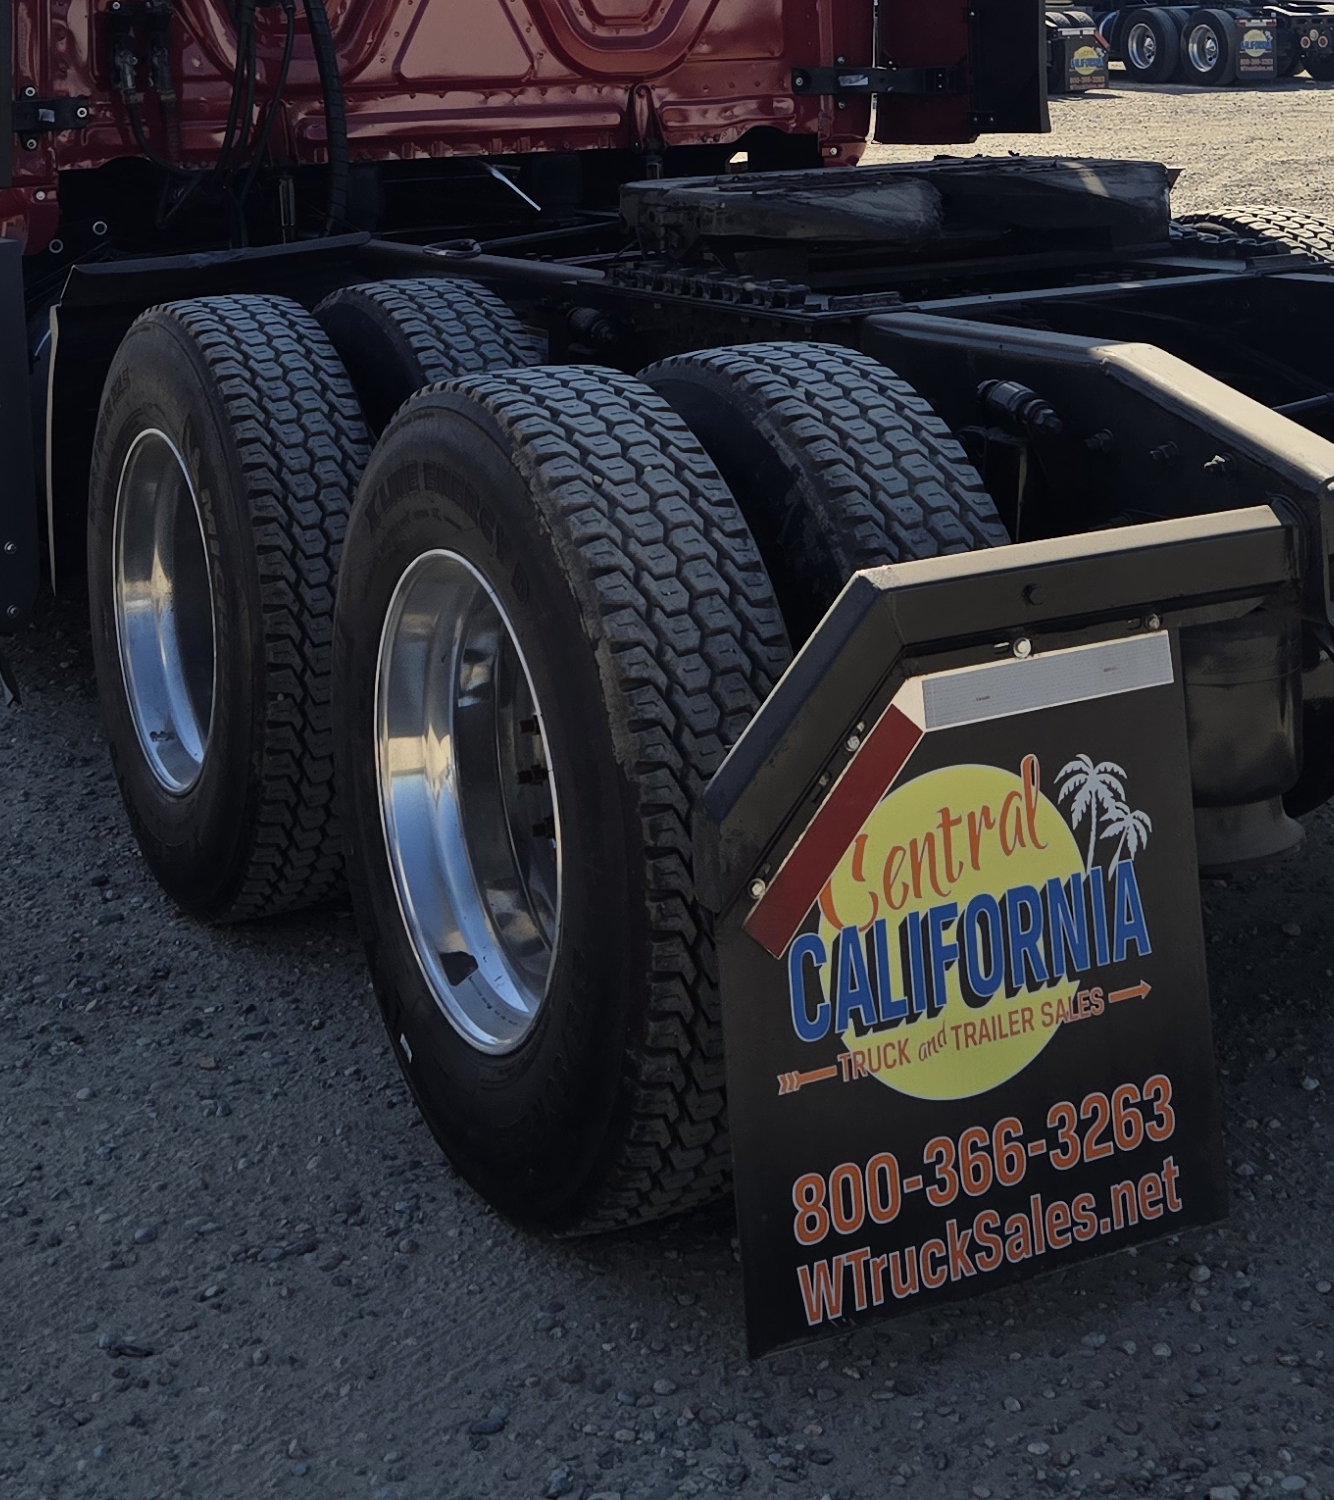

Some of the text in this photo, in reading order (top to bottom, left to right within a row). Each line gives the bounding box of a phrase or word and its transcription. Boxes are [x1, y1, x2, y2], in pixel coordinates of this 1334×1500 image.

[378, 459, 420, 513] LINE
[817, 753, 1050, 932] Central
[788, 859, 1153, 1043] CALIFORNIA
[838, 986, 1106, 1084] TRUCK and TRAILER SALES
[791, 1073, 1176, 1247] 800-366-3263
[797, 1155, 1184, 1327] WTruckSales.net
